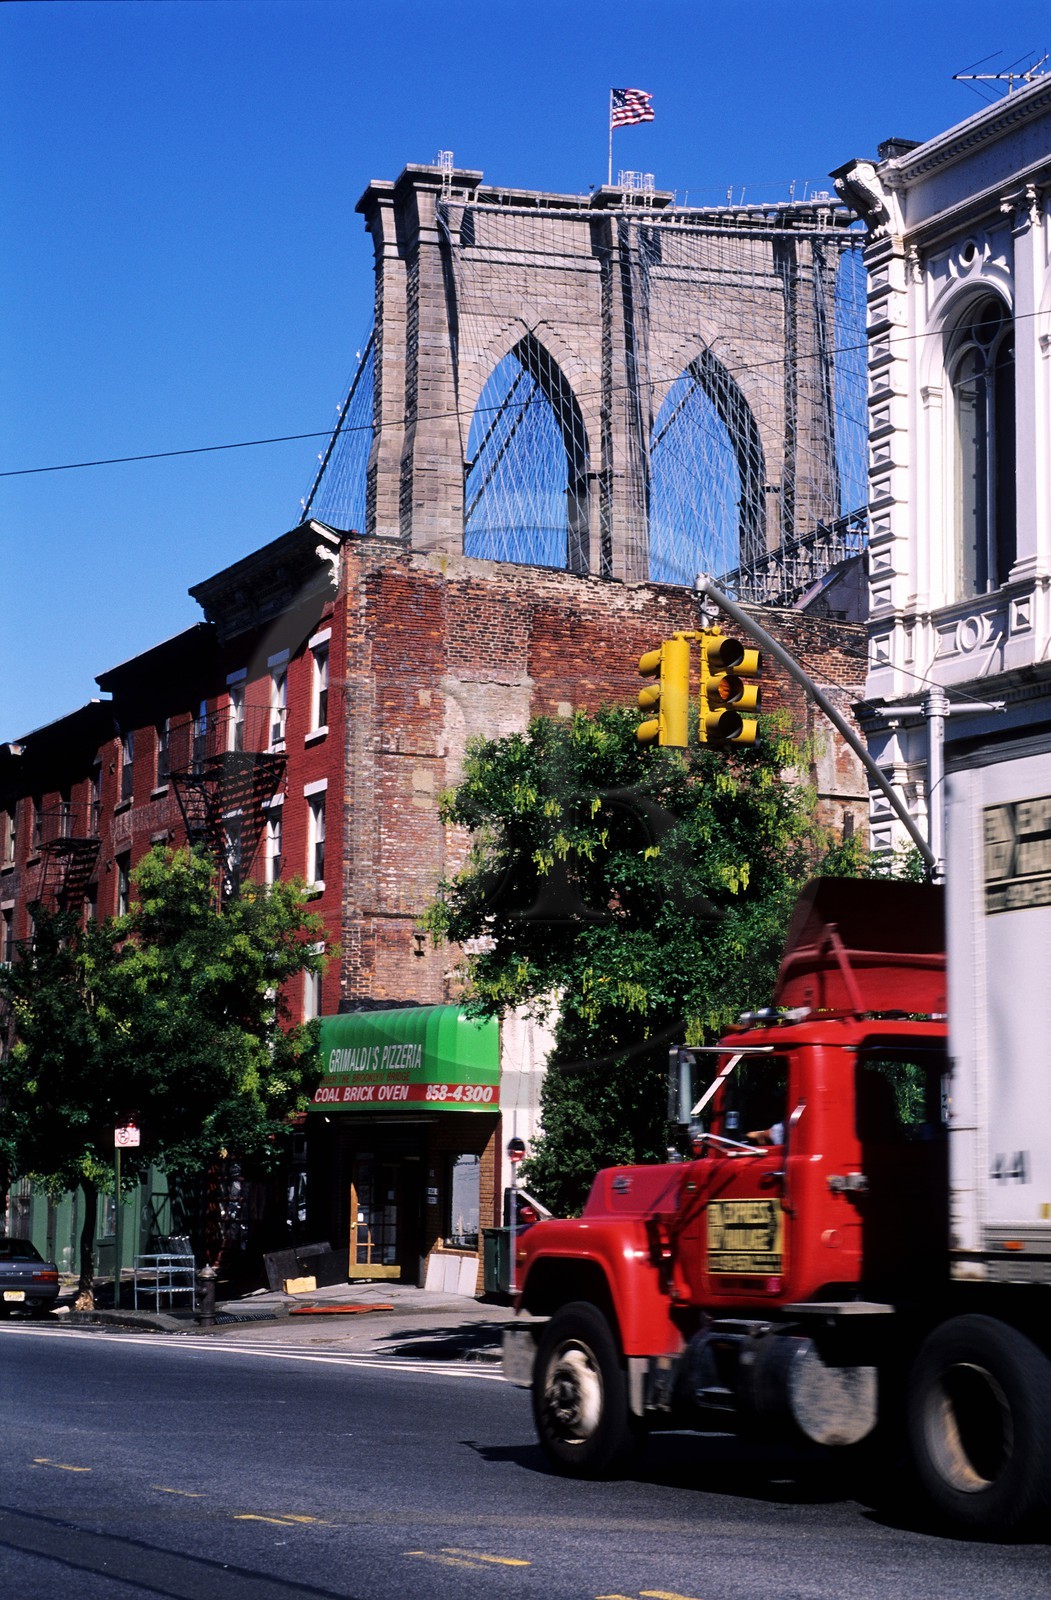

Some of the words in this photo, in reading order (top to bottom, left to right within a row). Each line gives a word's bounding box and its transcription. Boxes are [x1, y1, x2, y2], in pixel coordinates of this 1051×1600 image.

[328, 1046, 380, 1073] GRIMALDI'S
[381, 1044, 422, 1070] PIZZERIA
[338, 1074, 350, 1084] THE
[352, 1072, 384, 1083] BROOKLYN
[386, 1070, 411, 1082] BRIDGE
[314, 1086, 340, 1103] COAL
[344, 1086, 375, 1101] BRICK
[378, 1085, 410, 1101] OVEN
[425, 1084, 493, 1103] 858-4300
